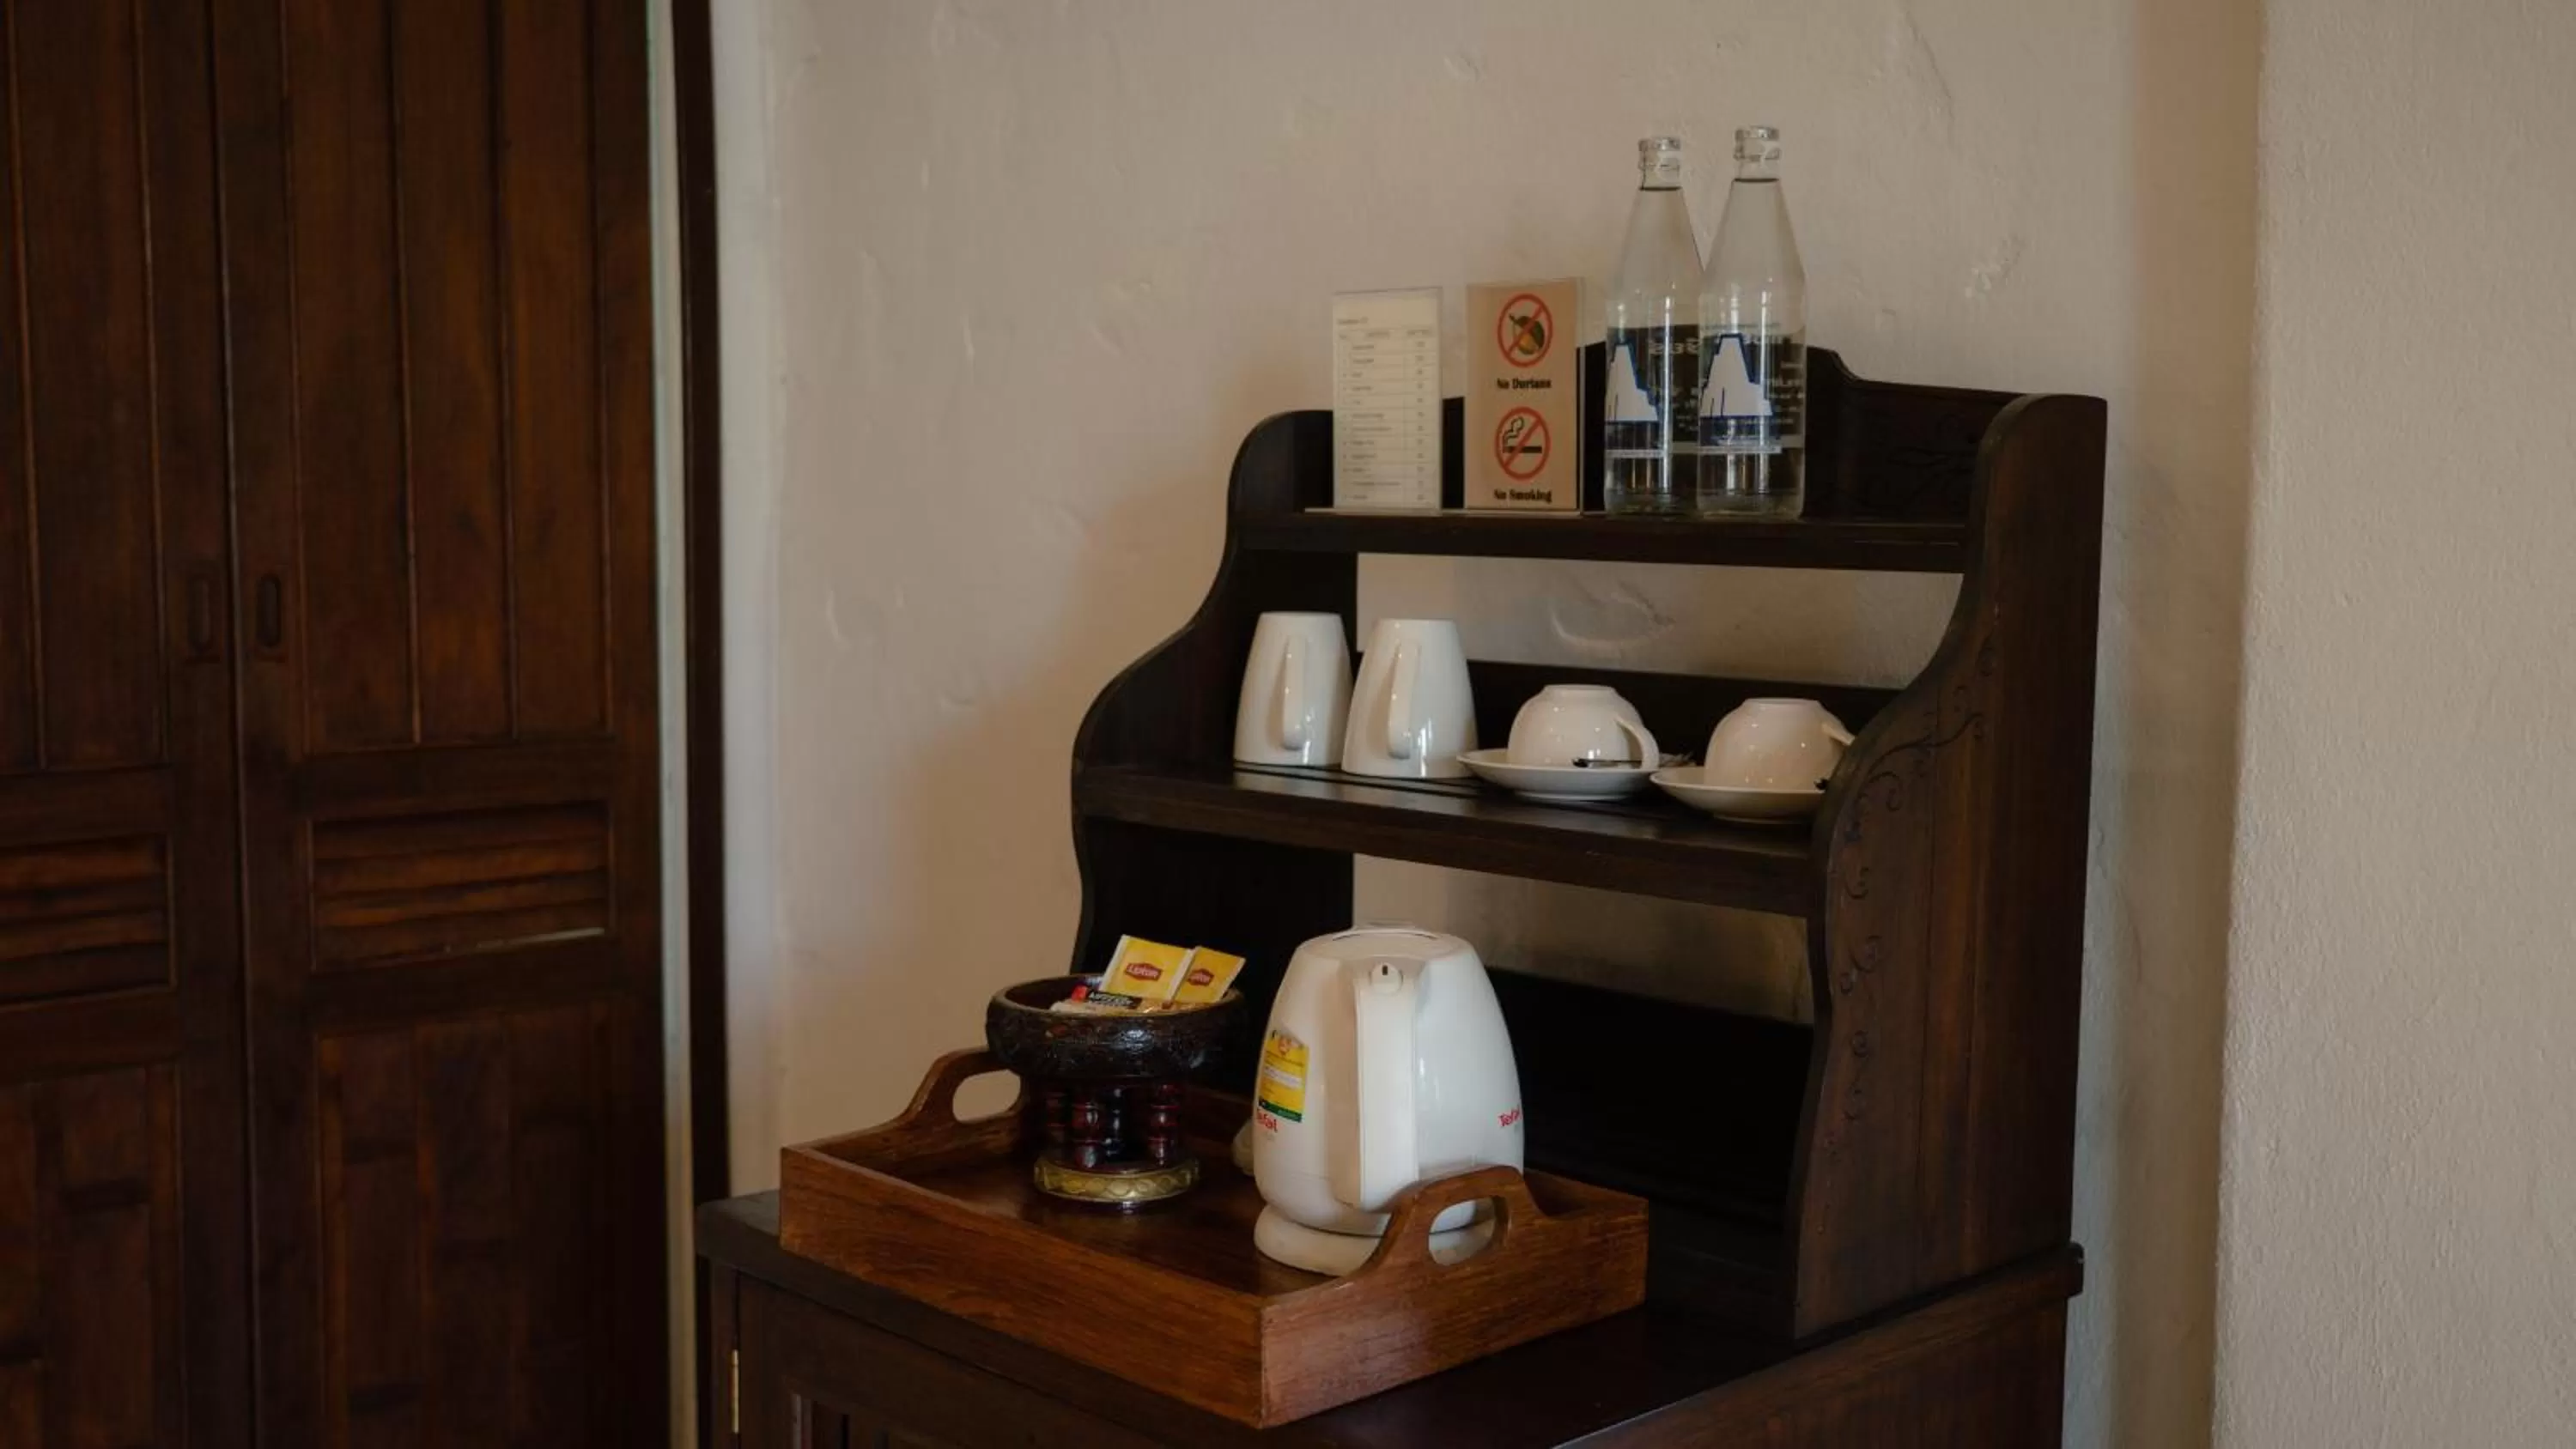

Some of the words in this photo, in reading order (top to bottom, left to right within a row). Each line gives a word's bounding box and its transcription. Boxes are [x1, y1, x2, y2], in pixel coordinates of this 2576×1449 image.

[1497, 378, 1510, 389] No
[1494, 489, 1507, 500] No
[1510, 488, 1552, 505] Smoking
